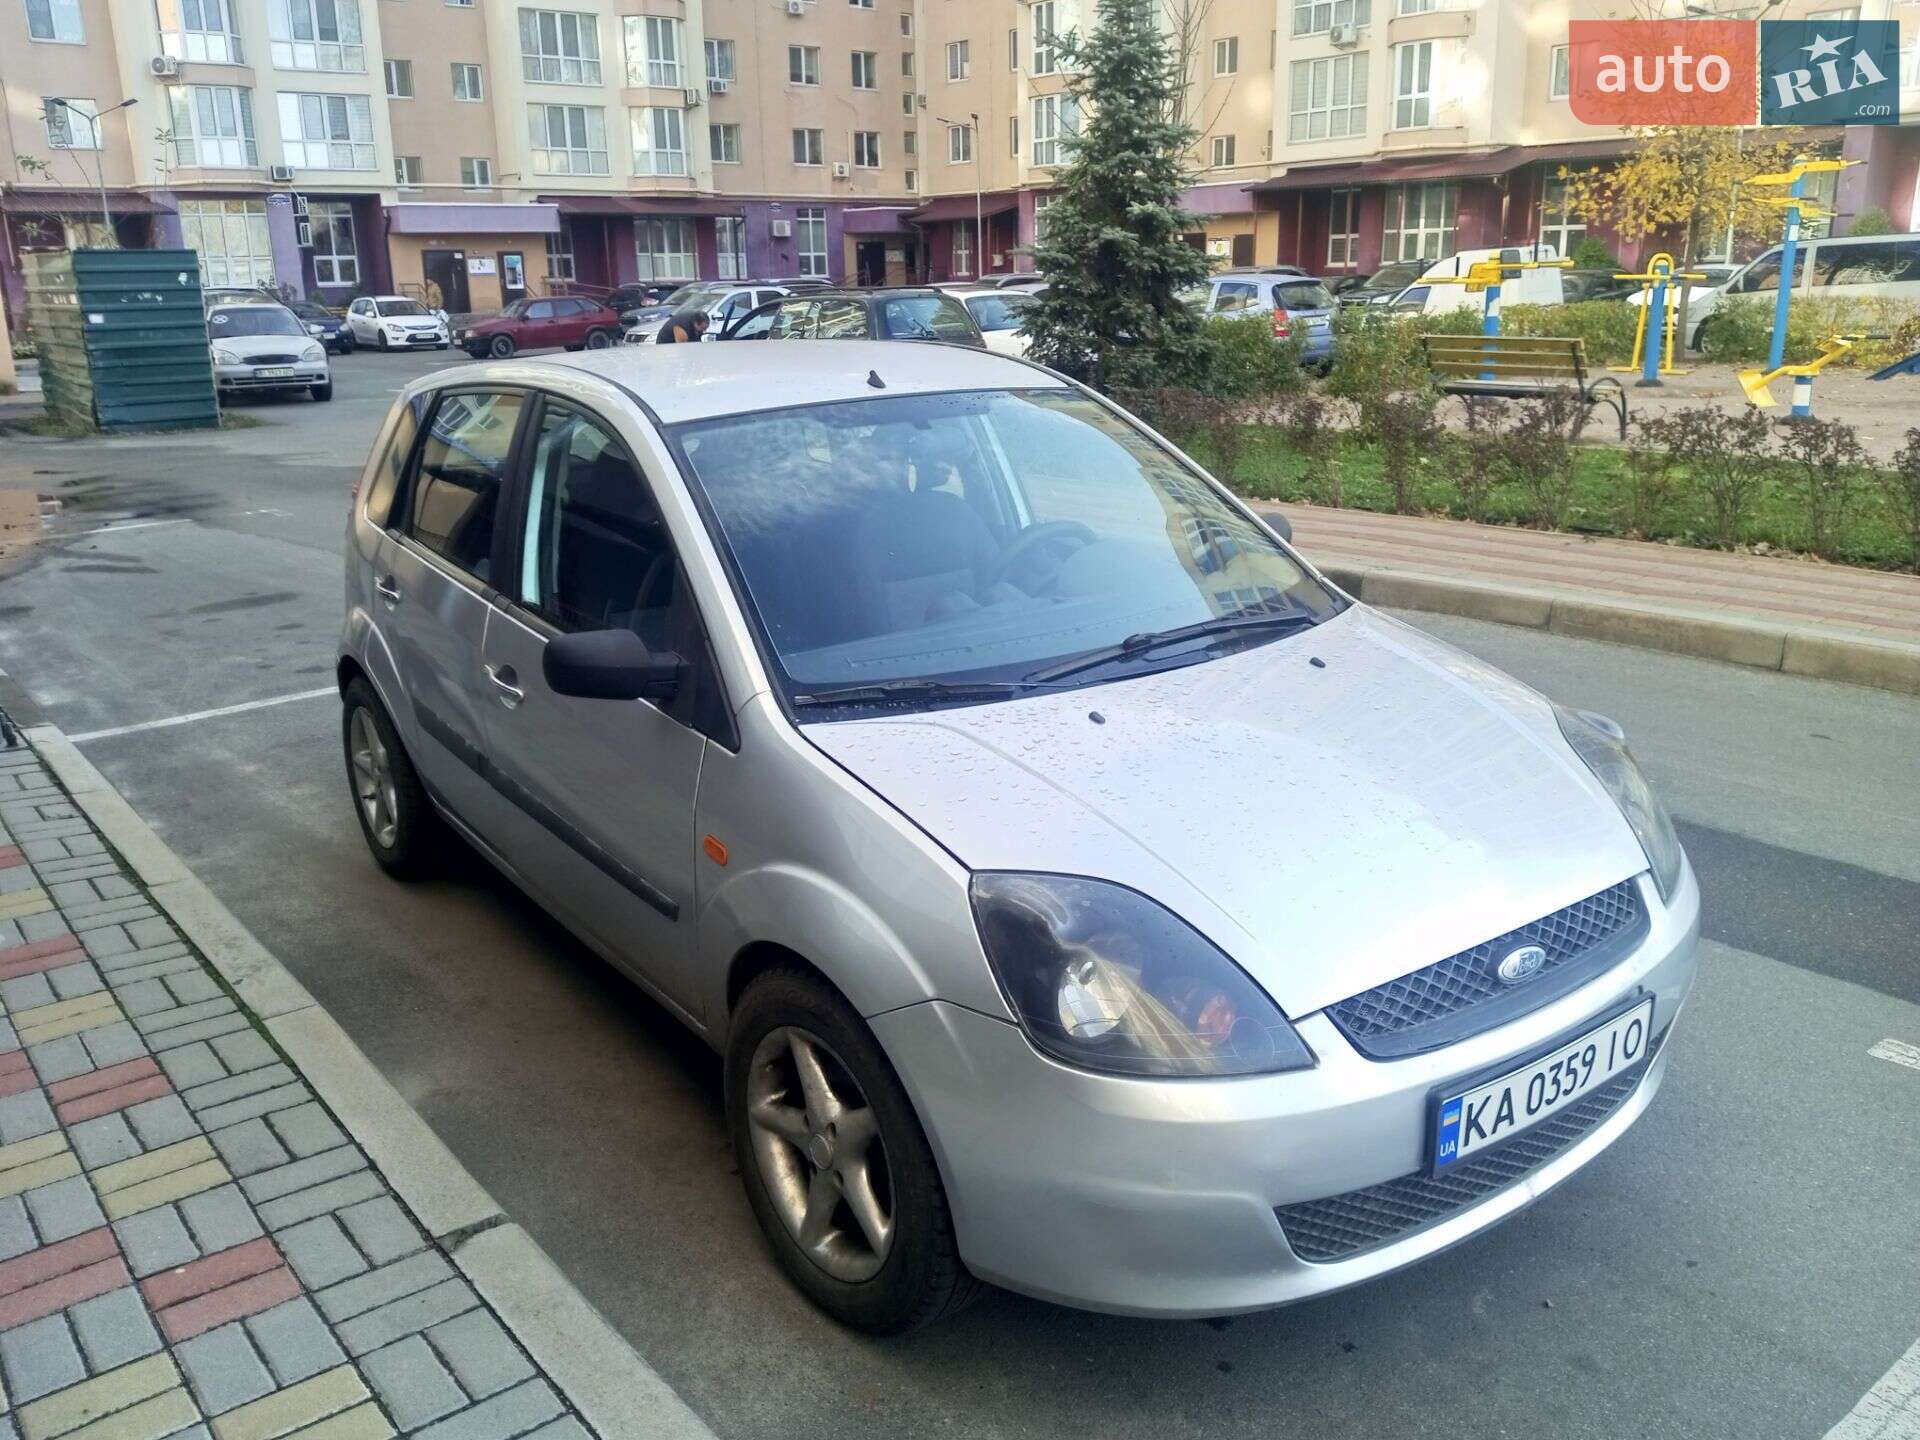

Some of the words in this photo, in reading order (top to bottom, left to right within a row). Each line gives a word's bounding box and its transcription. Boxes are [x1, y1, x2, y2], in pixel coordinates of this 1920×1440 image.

[1463, 1087, 1515, 1148] KA
[1526, 1044, 1597, 1116] 0359
[1440, 1142, 1456, 1157] UA
